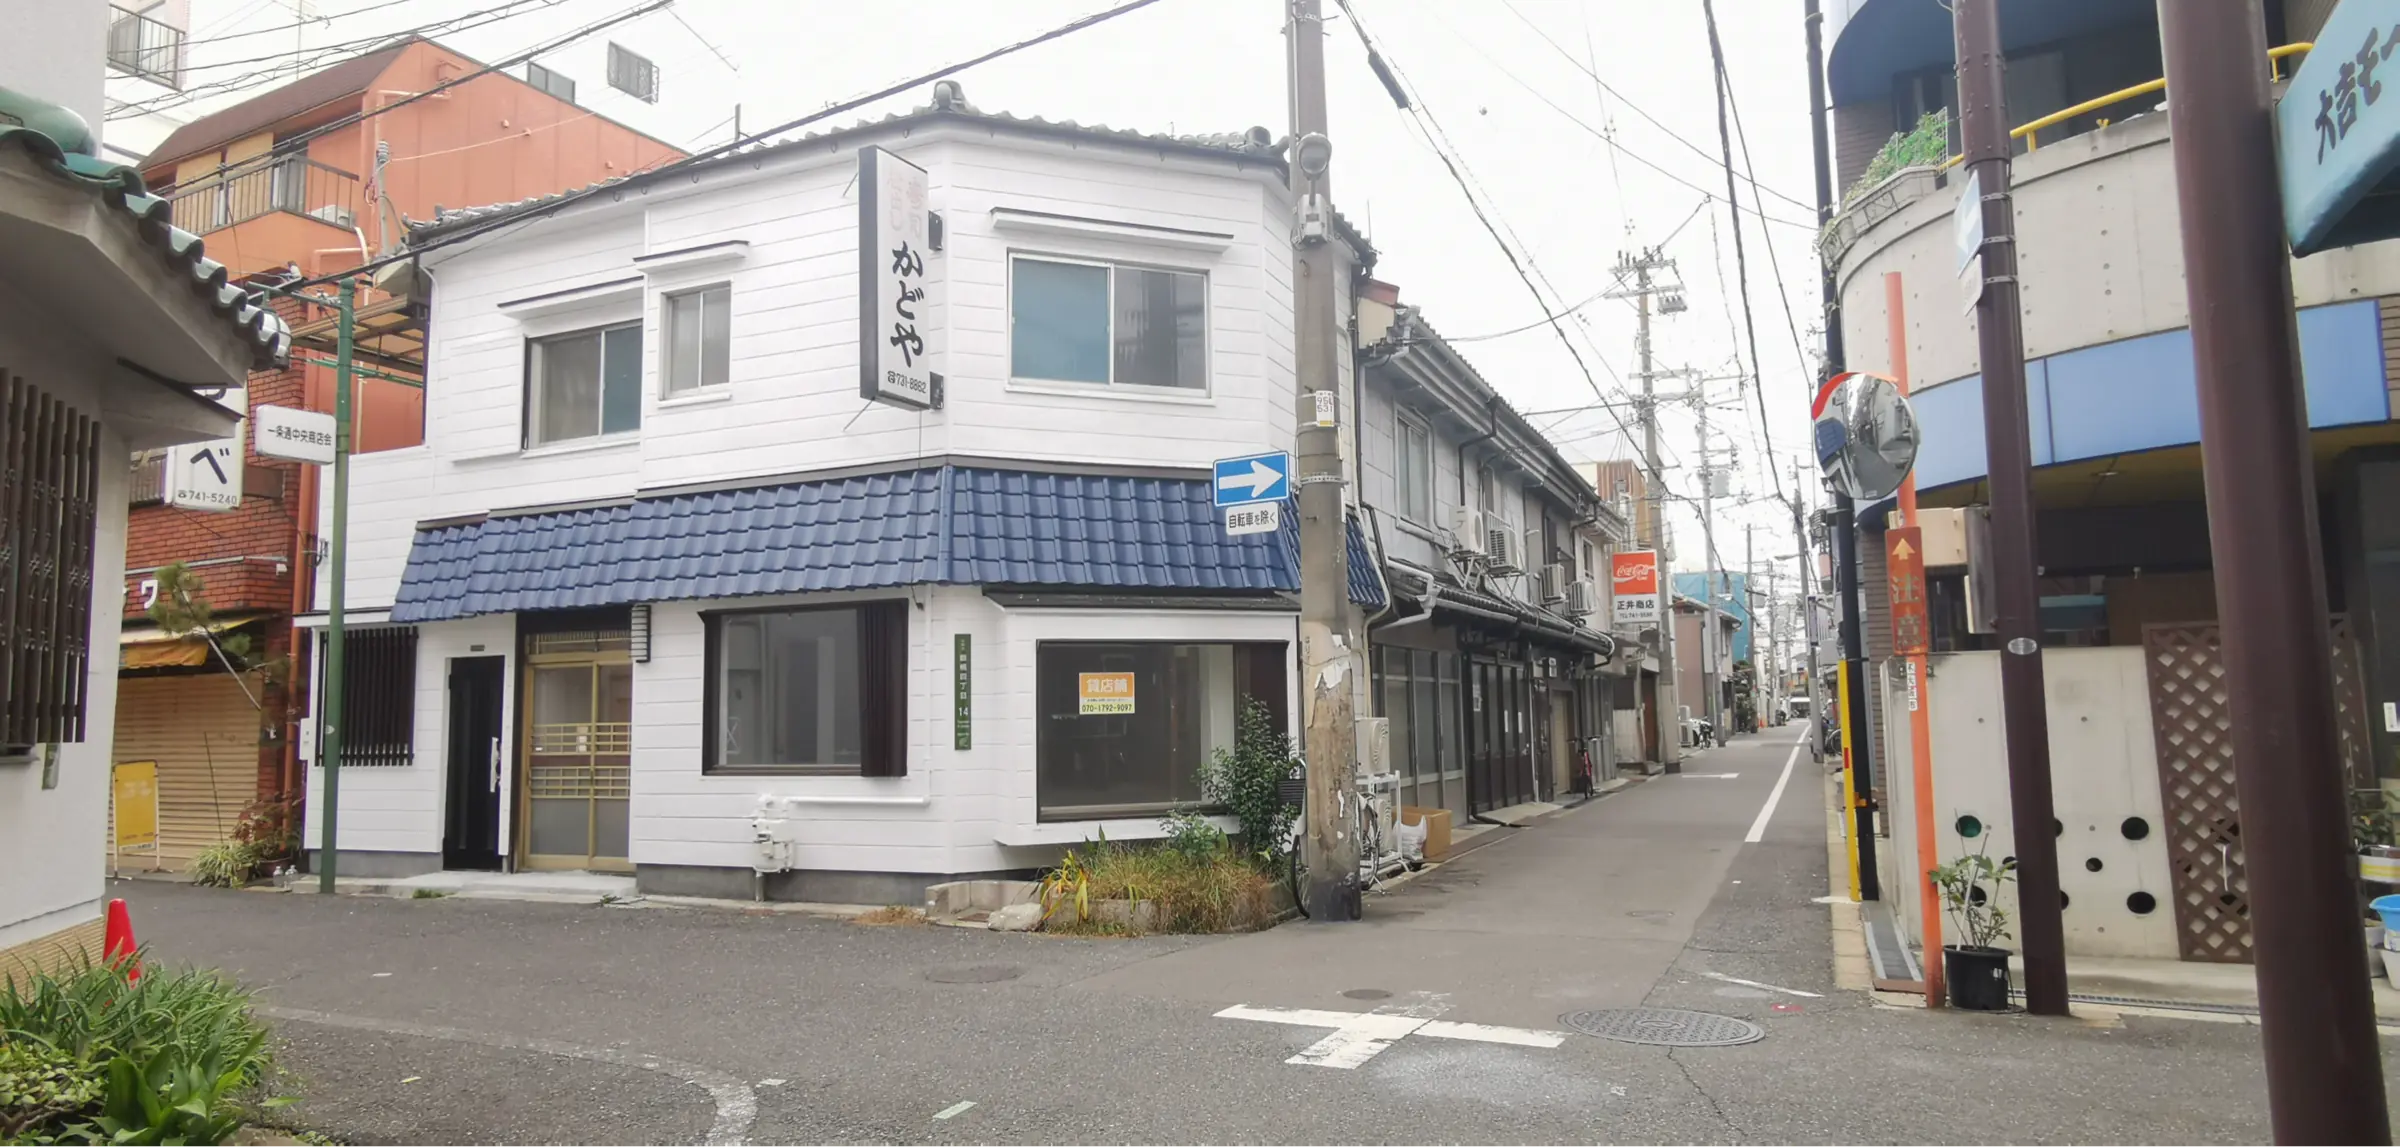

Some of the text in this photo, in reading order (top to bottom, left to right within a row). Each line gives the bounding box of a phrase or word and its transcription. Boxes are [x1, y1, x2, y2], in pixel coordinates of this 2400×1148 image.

[890, 240, 925, 368] かどや
[267, 425, 333, 446] 一条通中央商店会
[188, 490, 237, 505] 741-5240
[1229, 510, 1276, 528] 自転車を除く
[1616, 600, 1655, 611] 正井商店
[1086, 678, 1128, 693] 貸店舗
[958, 706, 969, 717] 14
[1081, 703, 1133, 713] 070-1792-9097
